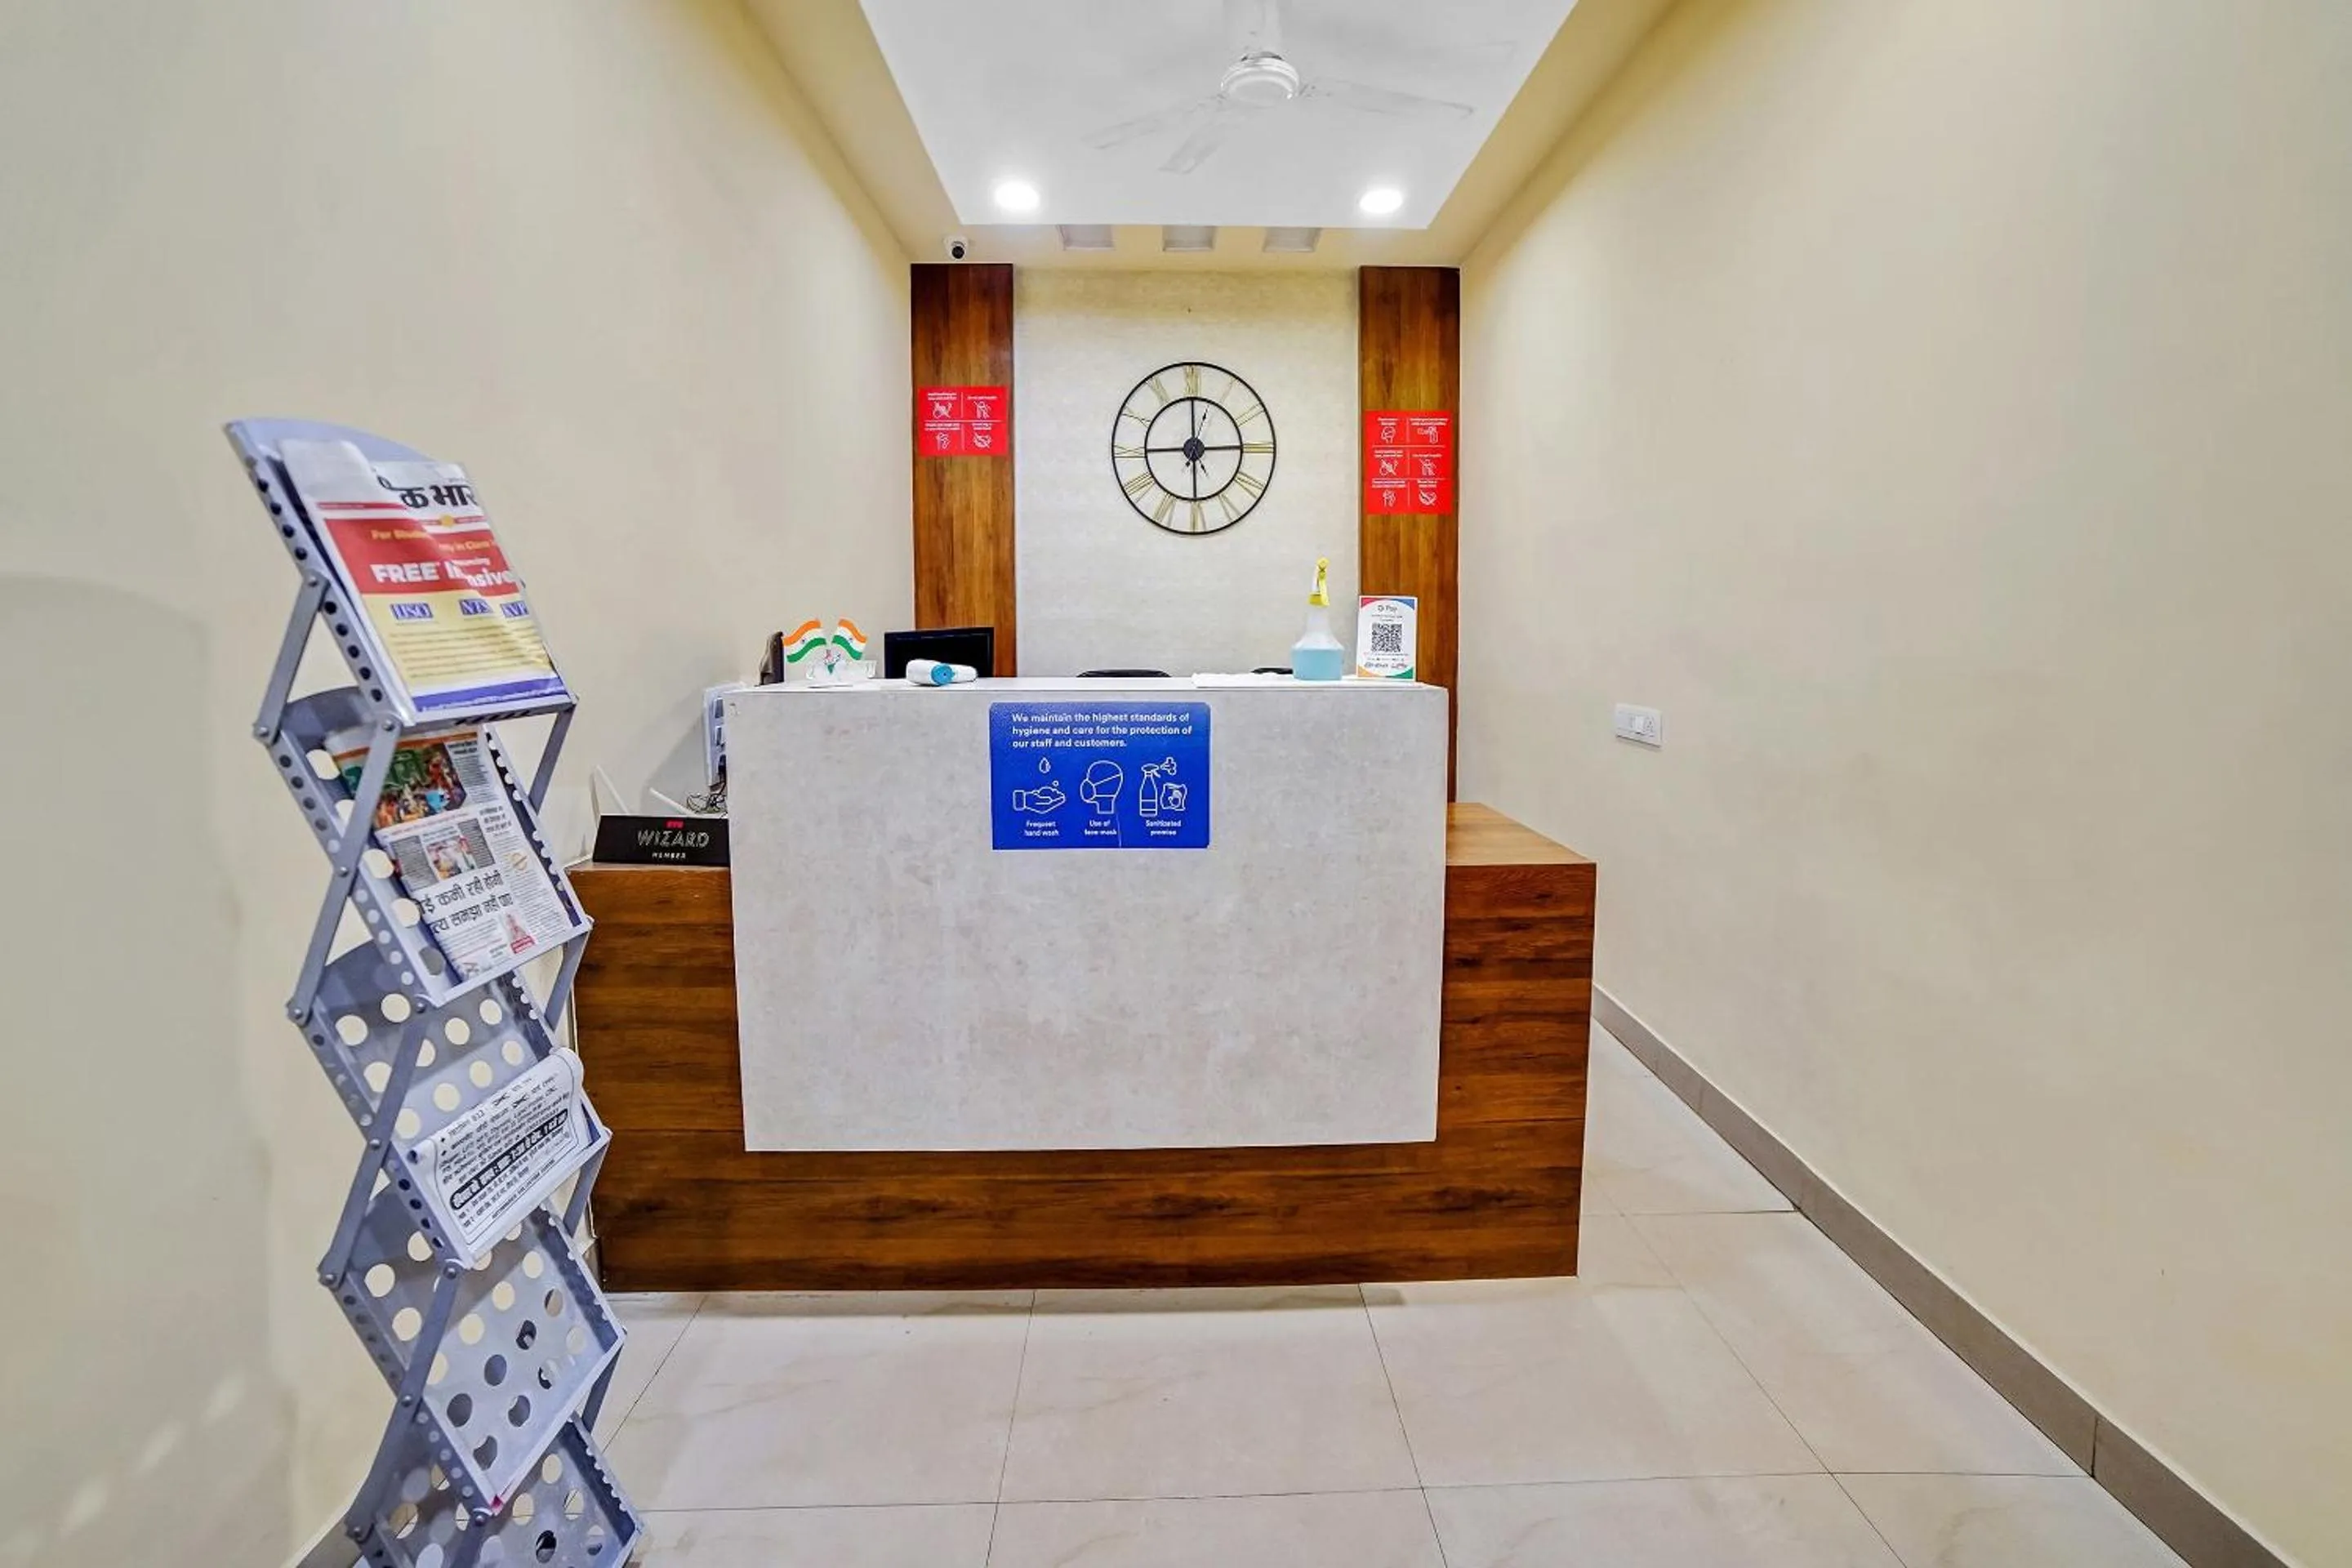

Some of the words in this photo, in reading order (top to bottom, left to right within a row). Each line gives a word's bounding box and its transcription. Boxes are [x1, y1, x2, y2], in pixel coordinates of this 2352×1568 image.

[1012, 713, 1028, 722] We
[1031, 712, 1072, 722] maintain
[1075, 713, 1090, 722] the
[1093, 712, 1128, 724] highest
[1130, 713, 1177, 722] standards
[1179, 712, 1189, 722] of
[1012, 725, 1050, 737] hygiene
[1053, 725, 1070, 734] and
[1095, 725, 1110, 734] for
[1111, 725, 1128, 734] the
[1130, 725, 1180, 736] protection
[1182, 725, 1192, 734] of
[1031, 738, 1052, 747] staff
[1054, 738, 1072, 747] and
[1074, 738, 1127, 747] customers.
[638, 830, 709, 848] WIZARD
